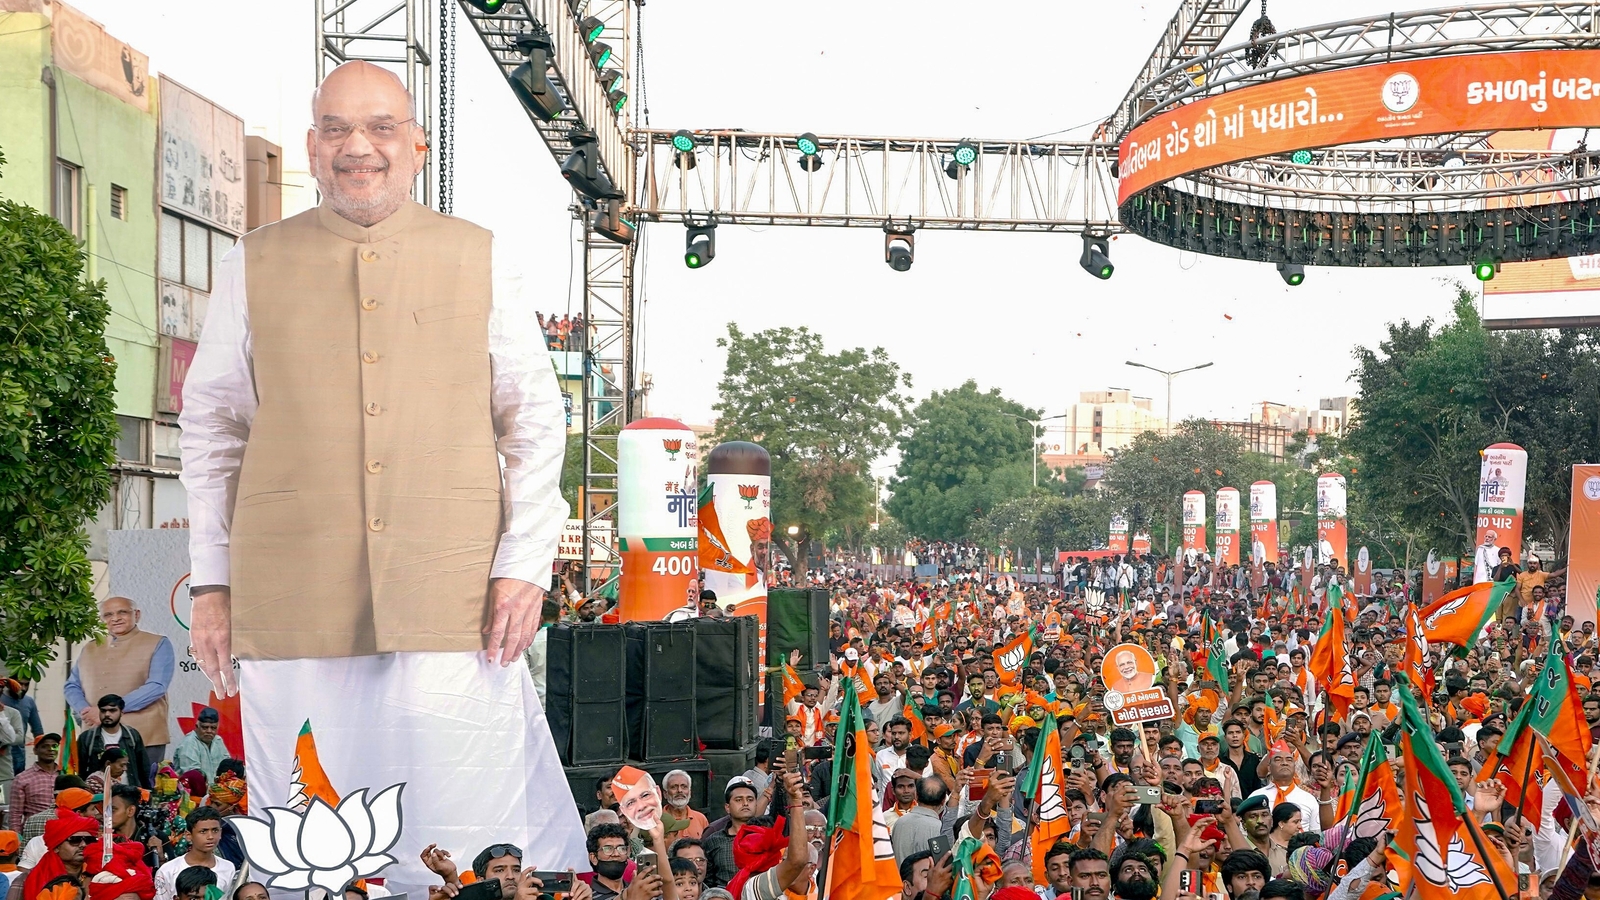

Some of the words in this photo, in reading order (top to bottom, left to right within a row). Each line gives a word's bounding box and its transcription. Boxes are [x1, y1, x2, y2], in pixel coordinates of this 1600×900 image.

[1467, 70, 1548, 113] કમળનું
[1165, 120, 1190, 157] રોડ
[1193, 109, 1217, 148] શો
[1224, 105, 1244, 139] માં
[1493, 517, 1512, 529] પાર
[559, 546, 595, 555] BAKEY
[670, 541, 687, 549] અબ
[652, 556, 692, 576] 400
[1118, 707, 1138, 721] મોદી
[1139, 704, 1170, 718] સરકાર
